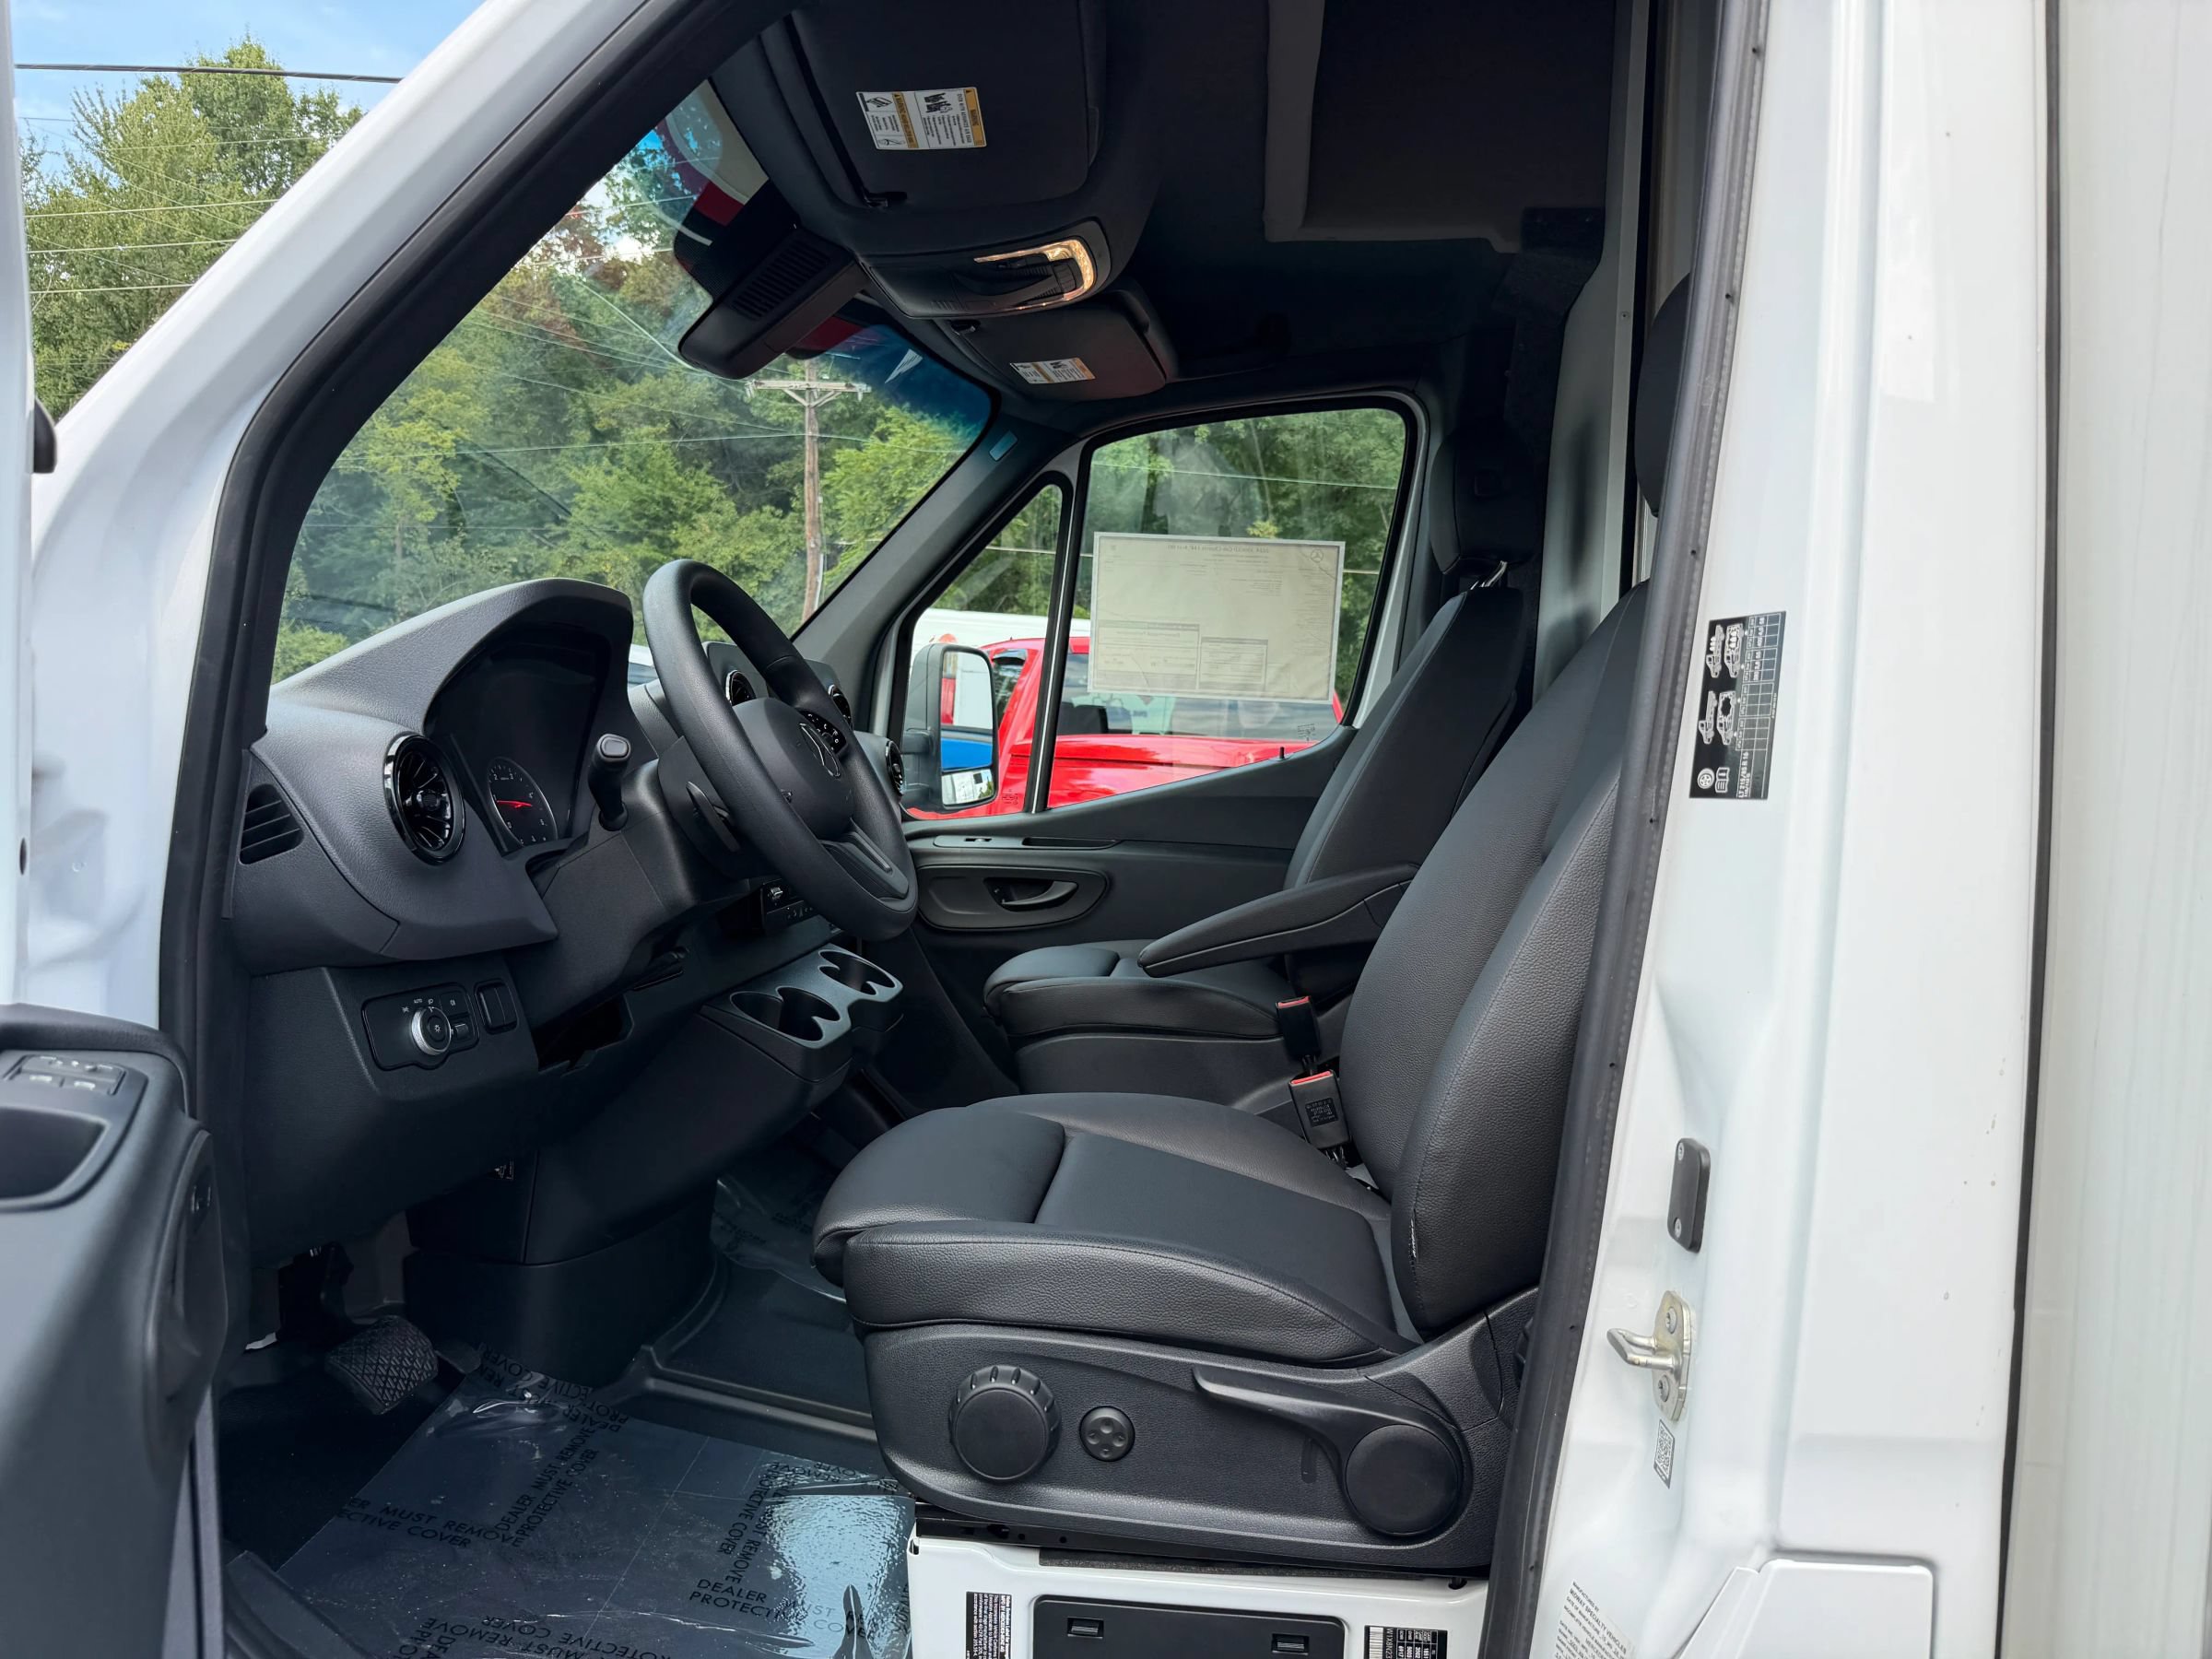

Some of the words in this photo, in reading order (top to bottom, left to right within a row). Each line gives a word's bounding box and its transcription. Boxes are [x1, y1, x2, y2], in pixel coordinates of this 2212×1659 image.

[496, 1494, 537, 1531] DEALER
[532, 1463, 559, 1492] MUST
[557, 1427, 595, 1466] REMOVE
[517, 1479, 574, 1539] PROTECTIVE
[566, 1449, 599, 1478] COVER
[335, 1510, 399, 1531] ECTIVE
[407, 1525, 473, 1549] COVER
[380, 1506, 438, 1525] MUST
[442, 1520, 525, 1548] REMOVE
[717, 1523, 747, 1557] COVER
[724, 1539, 761, 1584] REMOVE
[696, 1578, 768, 1604] DEALER
[419, 1617, 513, 1647] REMOVE
[481, 1615, 551, 1639] COVER
[1570, 1588, 1586, 1607] MIDWAY
[1585, 1606, 1607, 1631] SPECIALTY
[1606, 1630, 1627, 1654] VEHICLES
